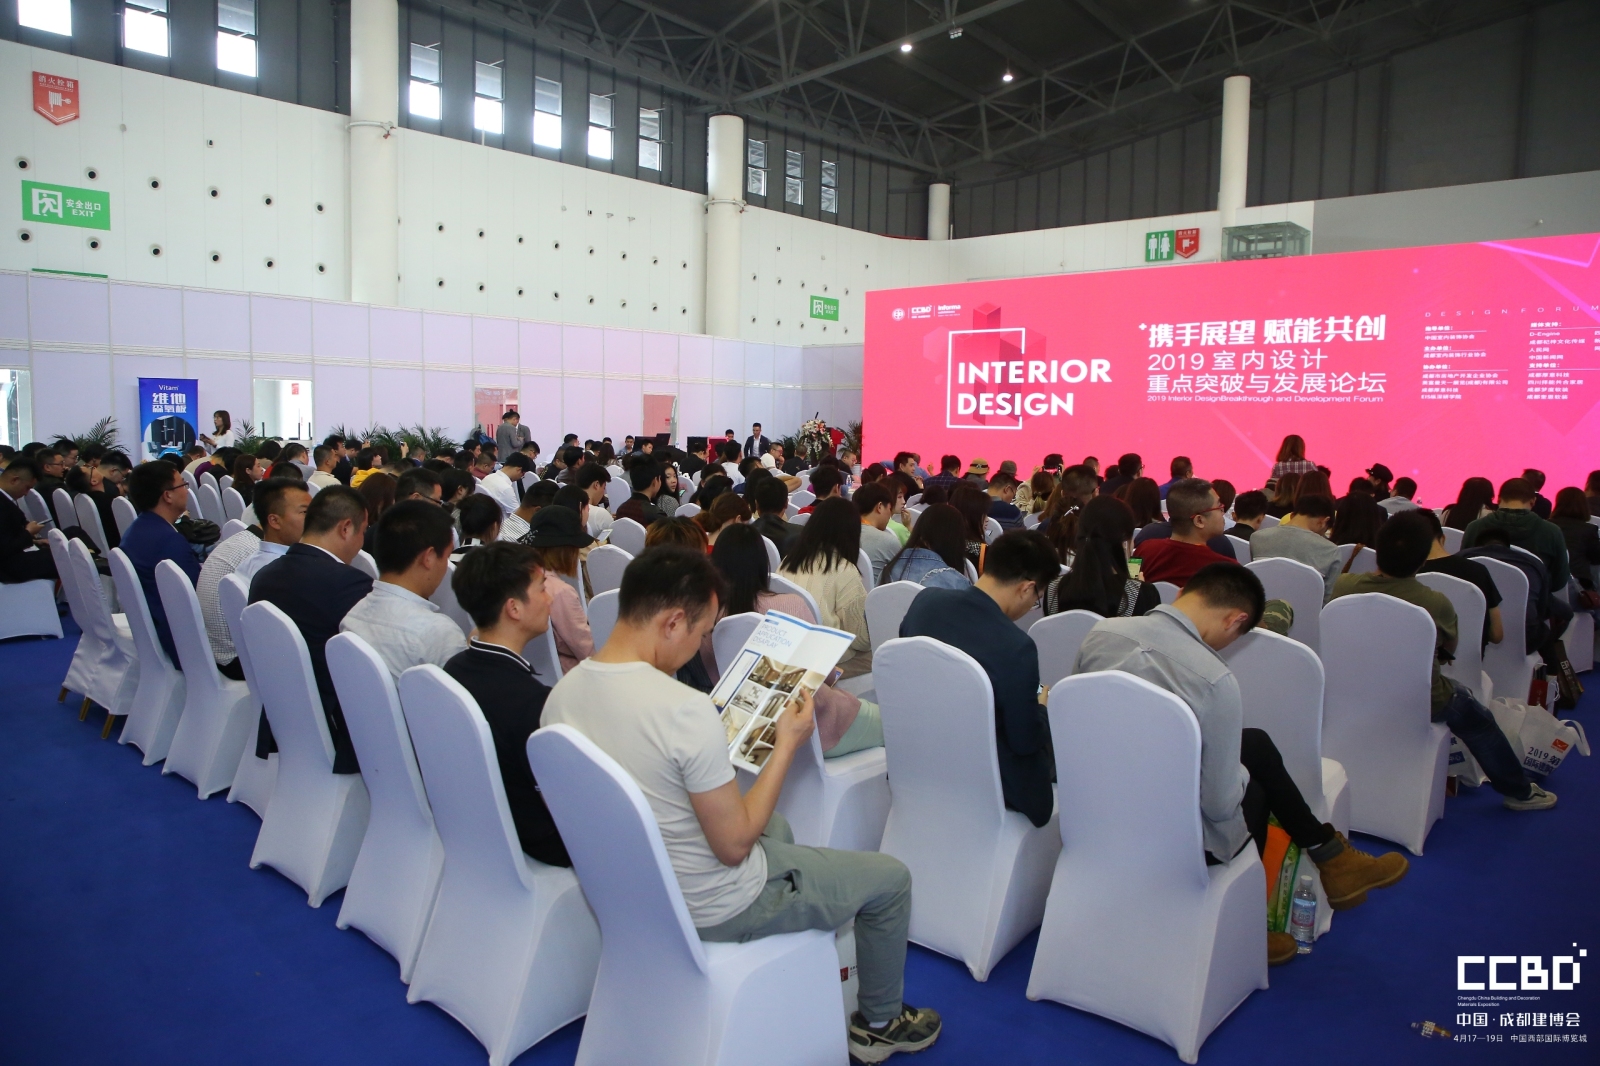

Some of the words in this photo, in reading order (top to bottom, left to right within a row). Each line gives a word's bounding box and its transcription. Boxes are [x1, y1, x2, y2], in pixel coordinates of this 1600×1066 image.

[38, 74, 74, 89] 消火栓箱
[65, 198, 101, 211] 安全出口
[72, 208, 95, 218] EXIT
[1148, 320, 1256, 348] 携手展望
[1263, 314, 1386, 344] 赋能共创
[1148, 353, 1204, 371] 2019
[1212, 348, 1328, 370] 室内设计
[958, 358, 1112, 384] INTERIOR
[1147, 372, 1387, 394] 重点突破与发展论坛
[152, 392, 186, 405] 维他
[957, 392, 1074, 416] DESIGN
[762, 624, 787, 636] PRODUCT
[758, 630, 792, 647] APPLICATION
[1528, 746, 1549, 760] 2019
